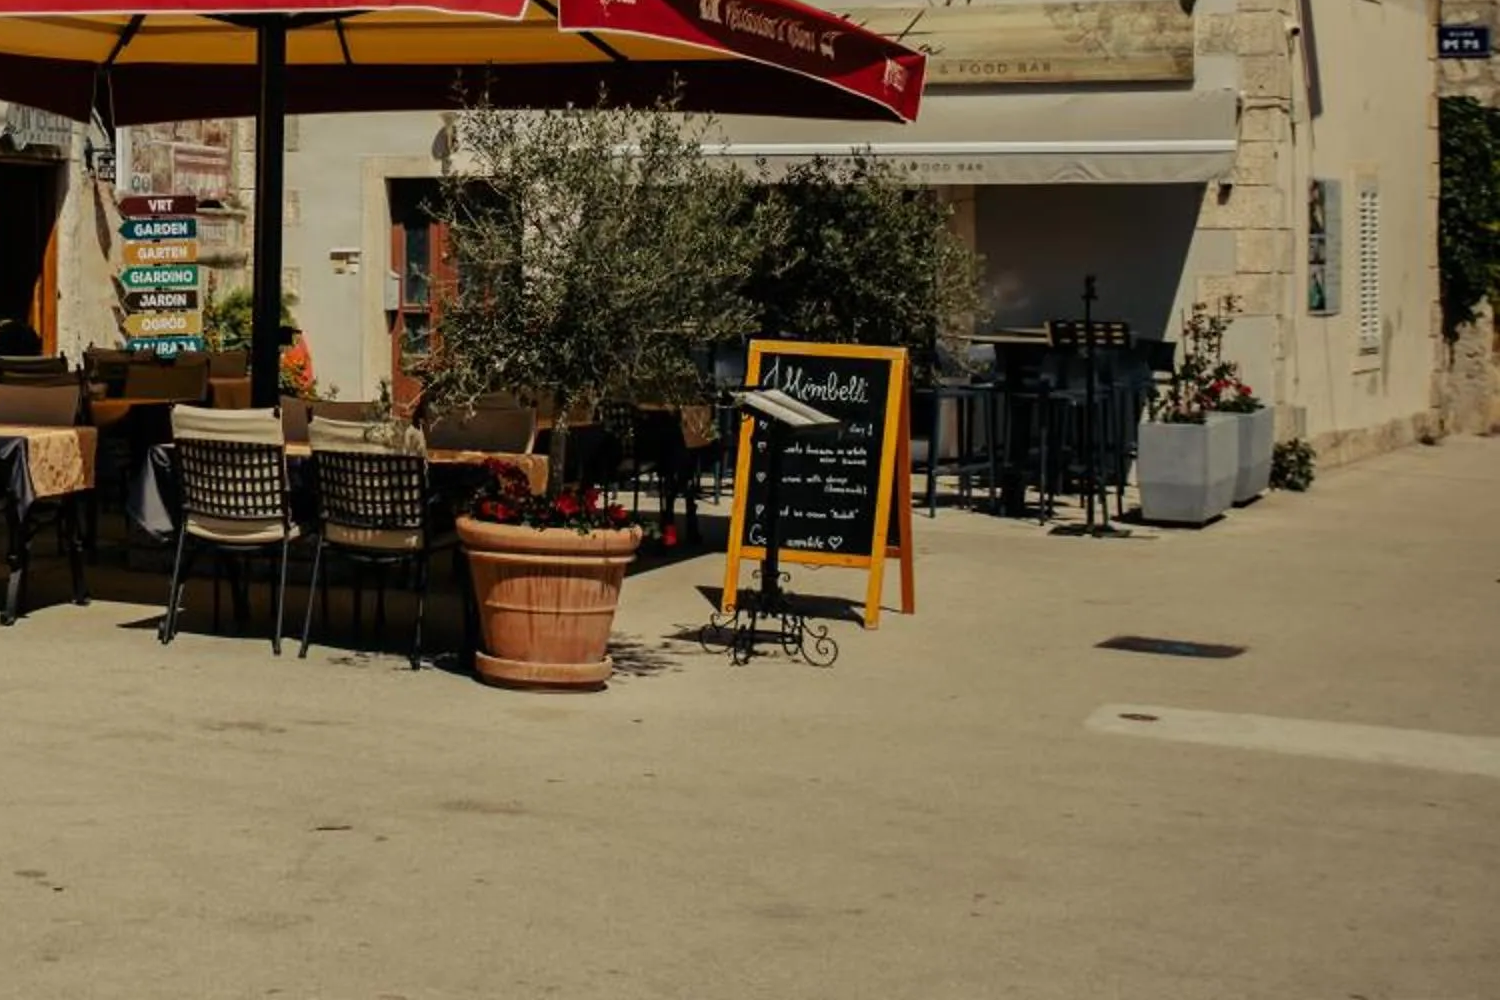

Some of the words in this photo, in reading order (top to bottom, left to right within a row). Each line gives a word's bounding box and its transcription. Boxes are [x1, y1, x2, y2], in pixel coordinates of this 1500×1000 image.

[147, 199, 174, 212] VRT
[133, 221, 189, 237] GARDEN
[130, 270, 193, 284] GIARDINO
[139, 293, 187, 308] JARDIN
[782, 365, 870, 404] Mimbelli
